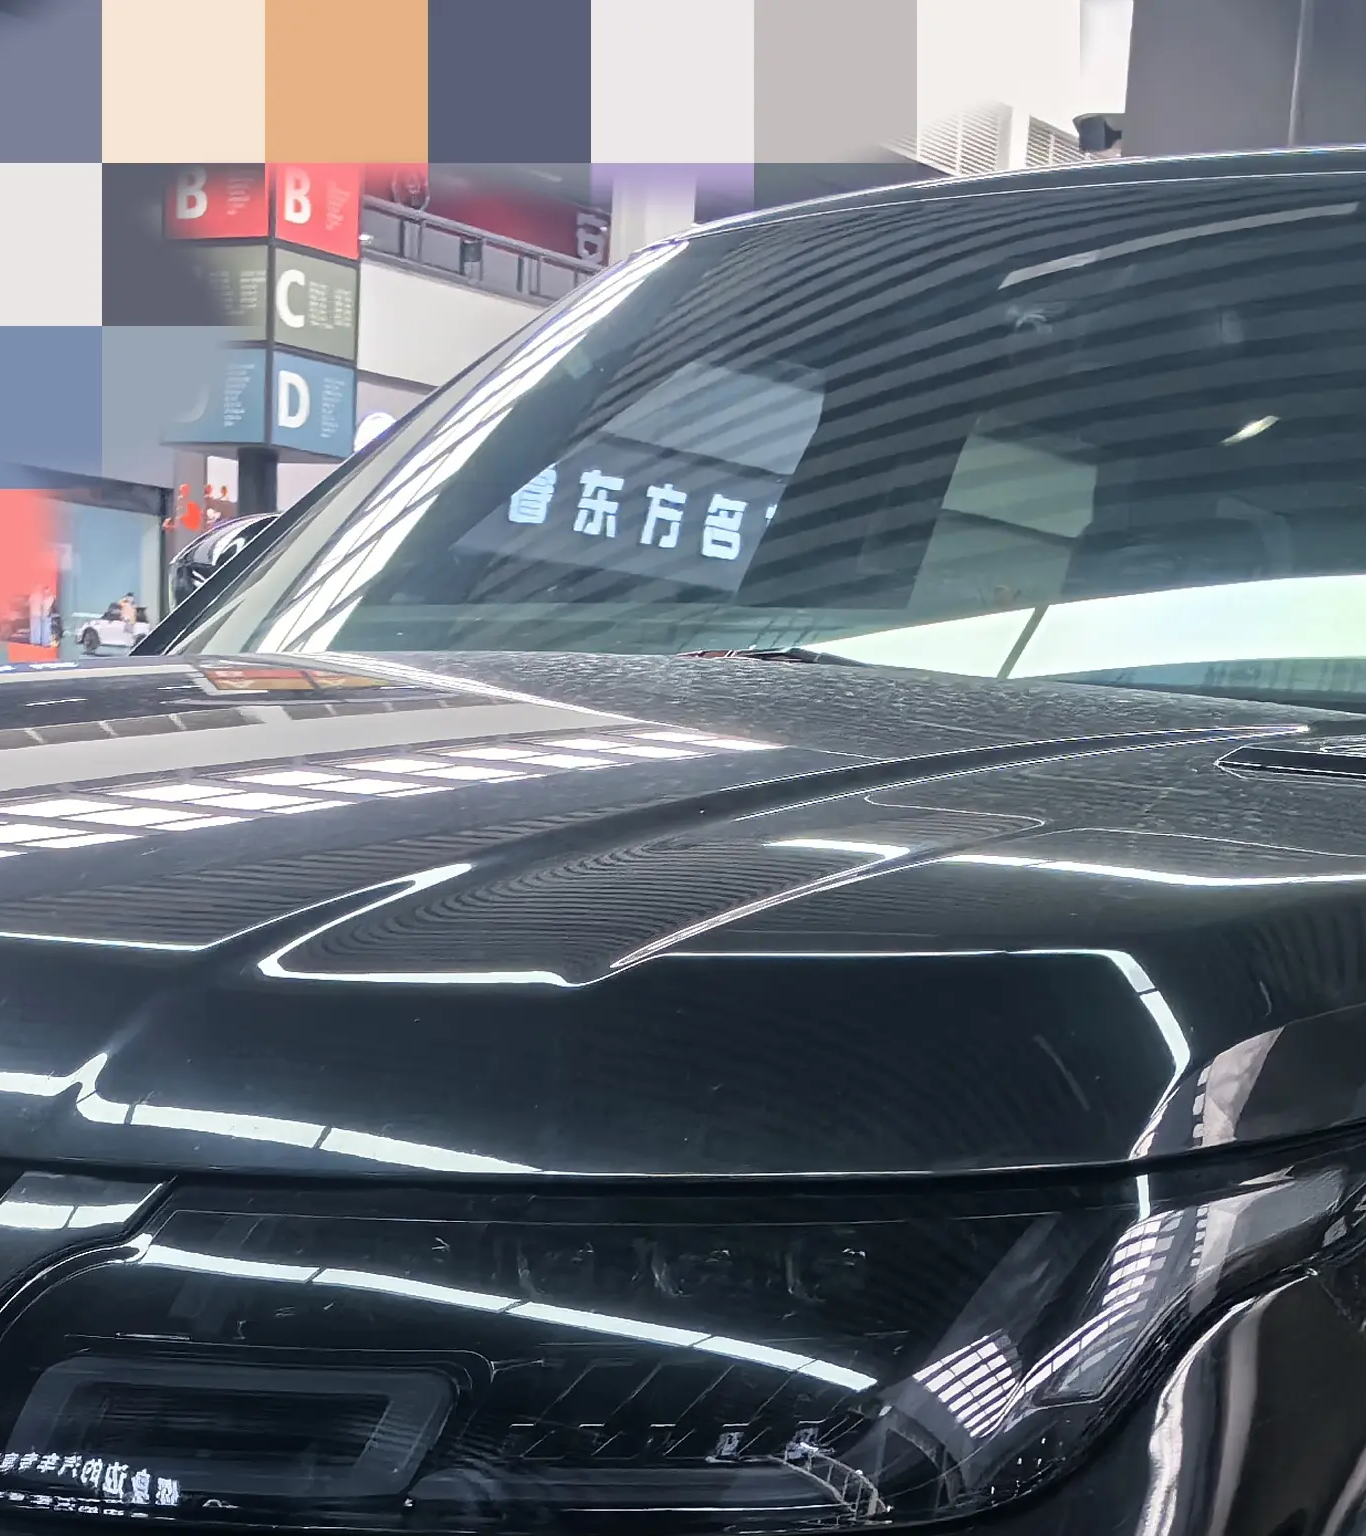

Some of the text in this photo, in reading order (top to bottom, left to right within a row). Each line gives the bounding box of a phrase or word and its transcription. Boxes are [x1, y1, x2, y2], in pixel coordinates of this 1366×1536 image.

[284, 166, 311, 224] B
[275, 269, 305, 328] C
[278, 370, 309, 428] D
